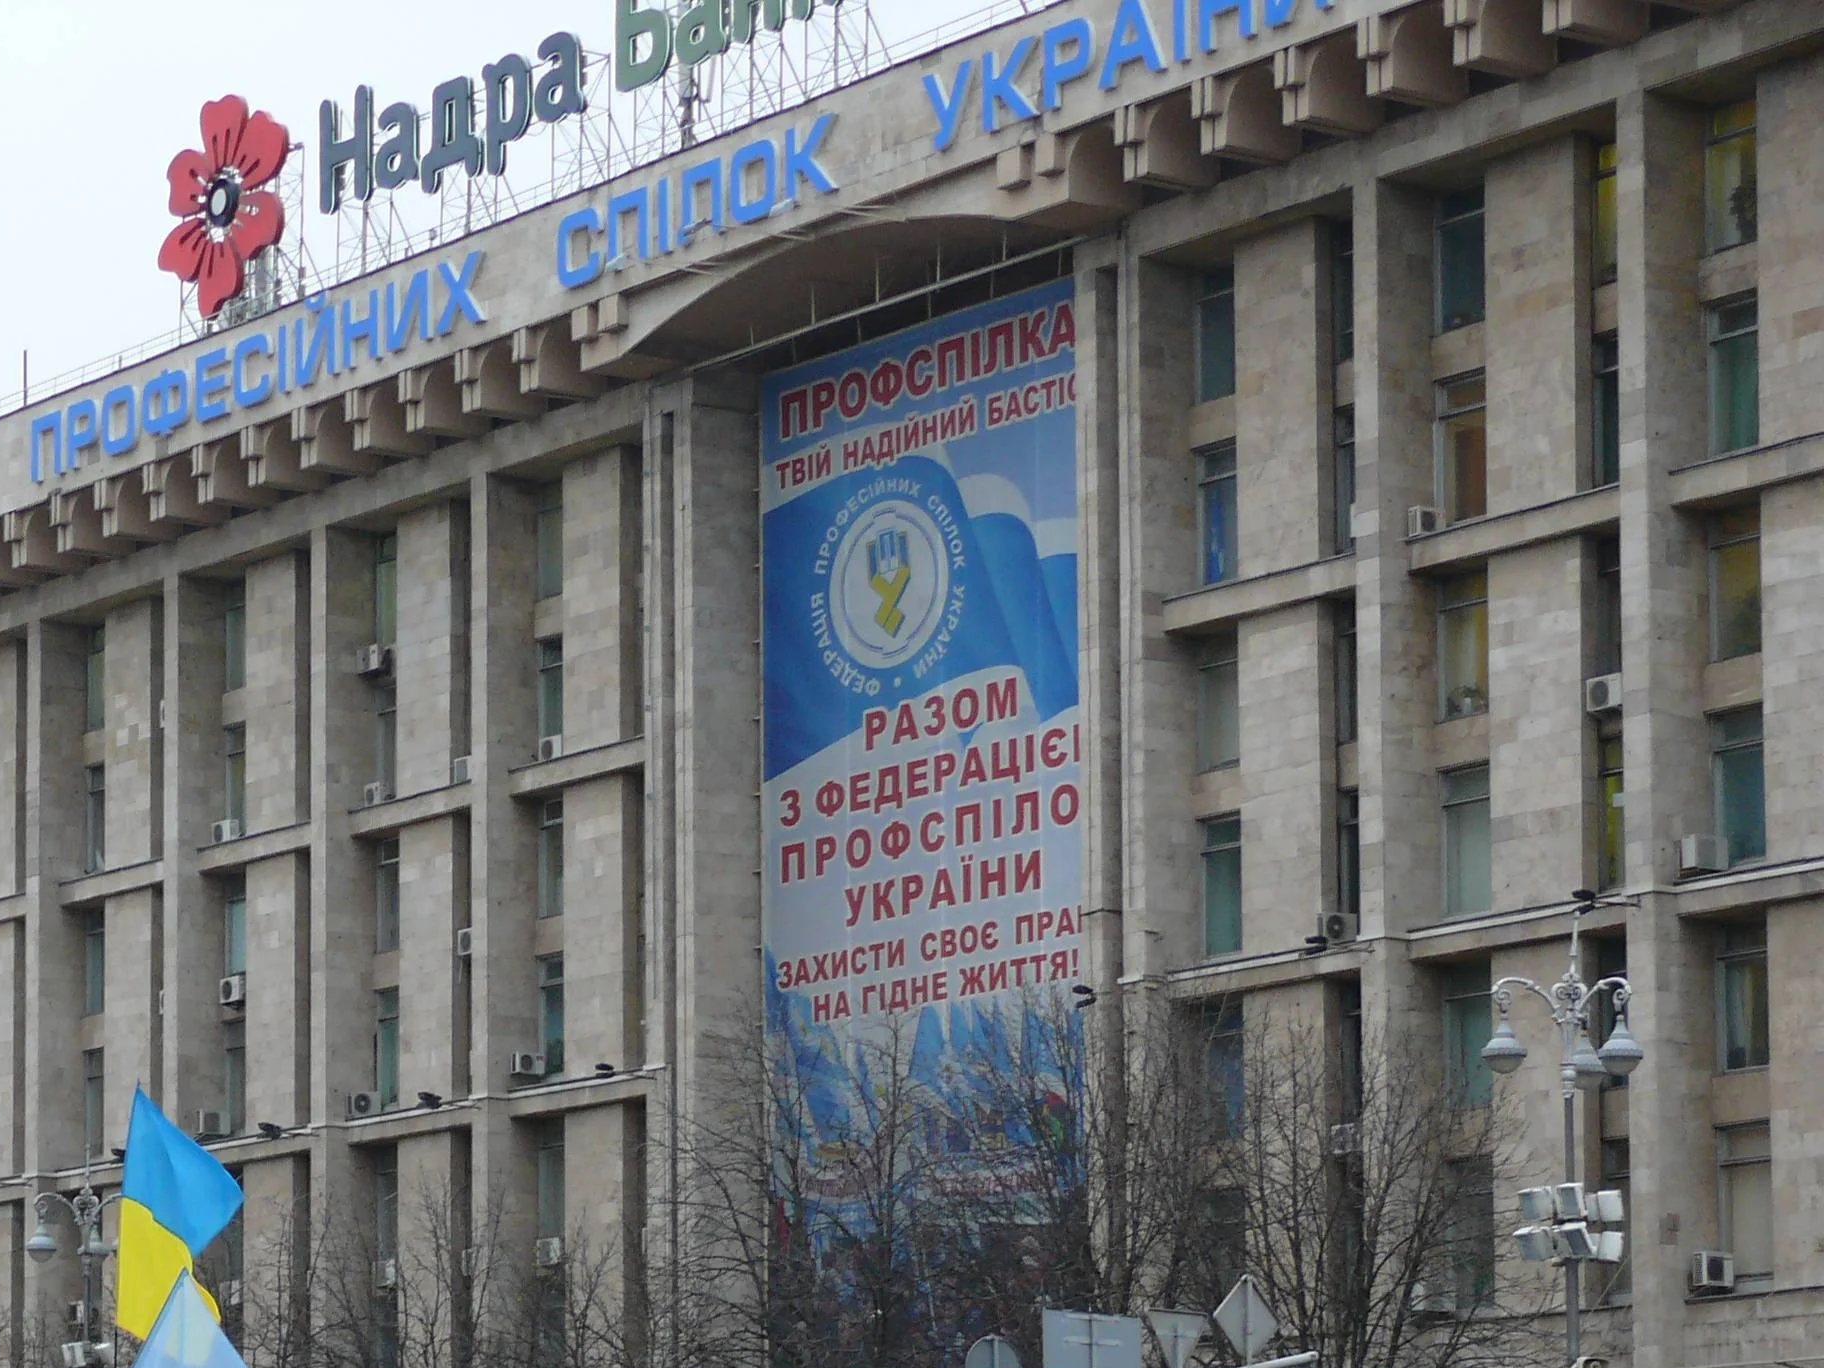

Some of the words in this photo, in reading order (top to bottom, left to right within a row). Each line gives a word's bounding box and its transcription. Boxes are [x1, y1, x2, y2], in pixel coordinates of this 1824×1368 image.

[319, 31, 586, 213] Надра
[615, 0, 843, 92] Бан
[30, 250, 487, 483] ПРОФЕСІЙНИХ
[555, 112, 840, 290] СПІЛОК
[780, 303, 1076, 439] ПРОФСПІЛКА
[775, 446, 832, 489] ТВІЙ
[842, 400, 976, 471] НАДІЙНИЙ
[814, 474, 921, 575] ПРОФЕСІЙНИХ
[928, 494, 968, 570] СПІЛОК
[811, 593, 880, 697] ФЕДЕРАЦІЯ
[912, 584, 966, 679] УКРАЇНИ
[865, 677, 1018, 751] РАЗОМ
[780, 790, 801, 827] З
[815, 724, 1080, 817] ФЕДЕРАЦІЄ
[844, 849, 1042, 927] УКРАЇНИ
[778, 939, 904, 989] ЗАХИСТИ
[920, 920, 999, 961] СВОЄ
[1015, 906, 1083, 944] ПРА
[814, 993, 850, 1023] НА
[863, 972, 947, 1013] ГІДНЕ
[959, 949, 1078, 995] ЖИТТЯ!
